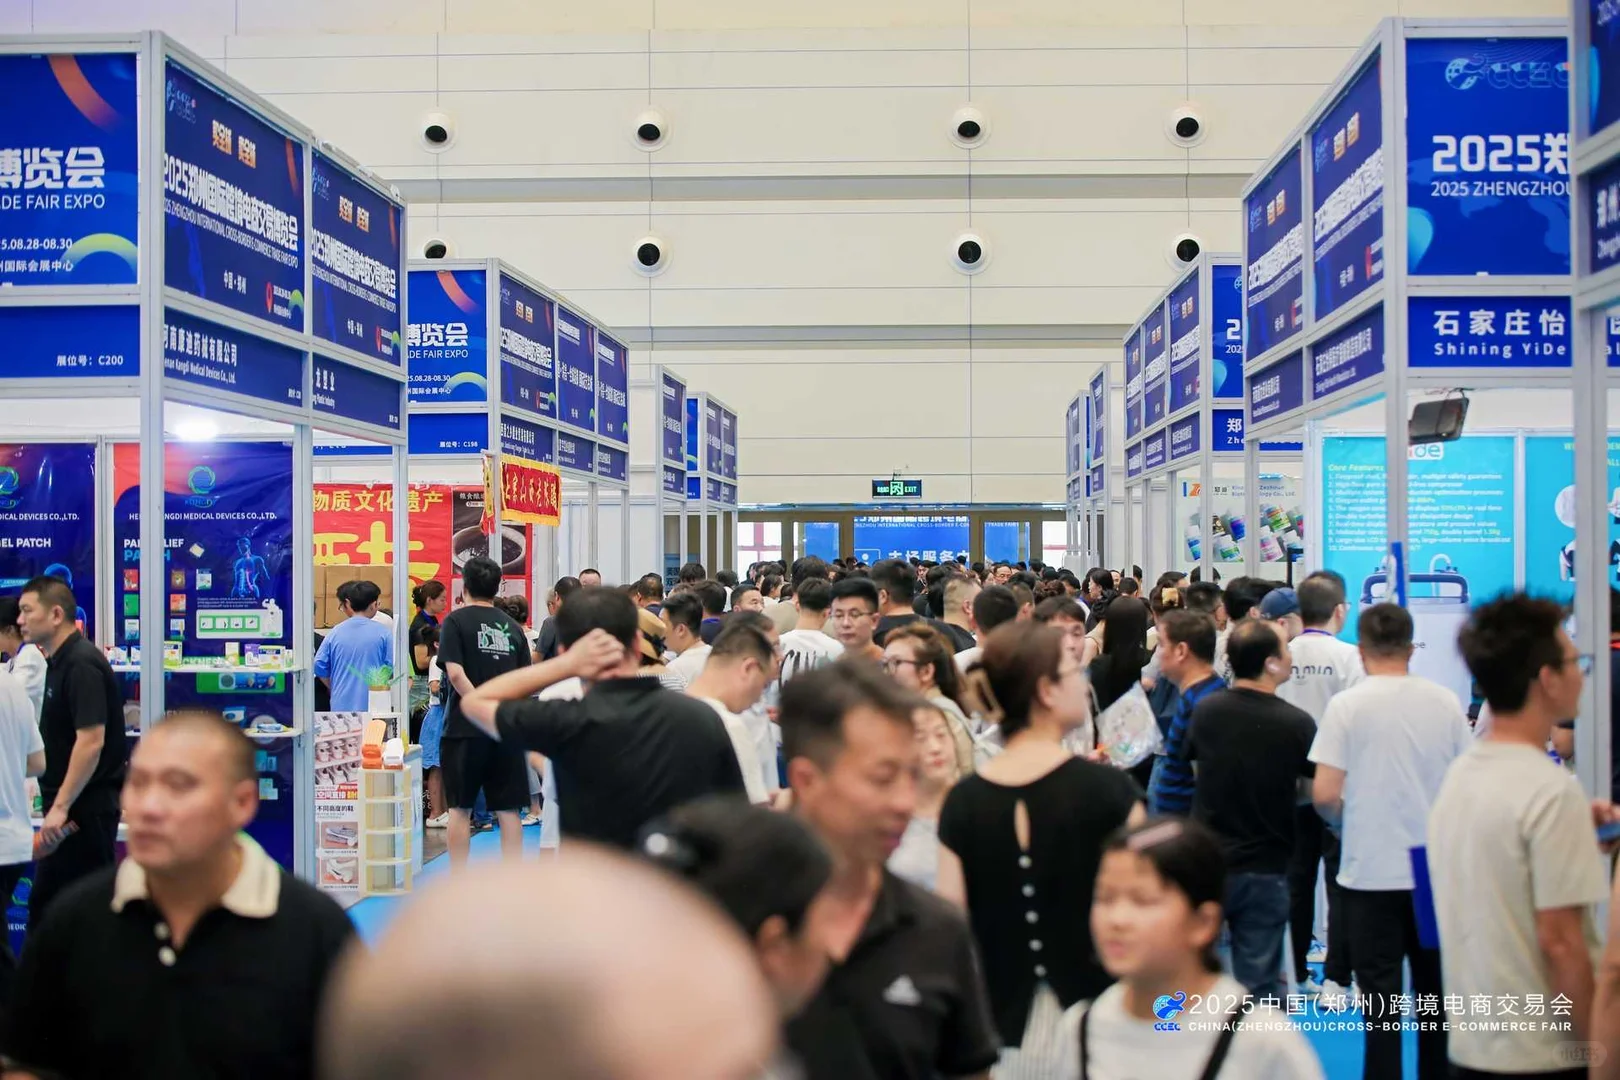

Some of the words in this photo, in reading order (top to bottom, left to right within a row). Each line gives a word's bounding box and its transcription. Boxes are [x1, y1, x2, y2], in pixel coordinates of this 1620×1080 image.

[1431, 181, 1469, 196] 2025
[0, 195, 21, 209] DE
[26, 195, 60, 209] FAIR
[64, 194, 105, 209] EXPO
[0, 259, 74, 271] 国际会展中心
[1433, 309, 1566, 336] 石家庄怡
[423, 350, 444, 358] FAIR
[445, 349, 468, 358] EXPO
[1434, 343, 1512, 359] Shining
[1522, 343, 1566, 355] YiDe
[164, 357, 175, 370] enan
[313, 490, 443, 513] 物质文化遗产
[49, 513, 80, 521] CO.,LTD.
[183, 512, 214, 520] MEDICAL
[216, 512, 245, 520] DEVICES
[247, 512, 277, 521] CO.,LTD.
[0, 538, 14, 548] EL
[16, 538, 52, 548] PATCH
[164, 539, 185, 548] LIEF
[124, 549, 171, 561] PAH
